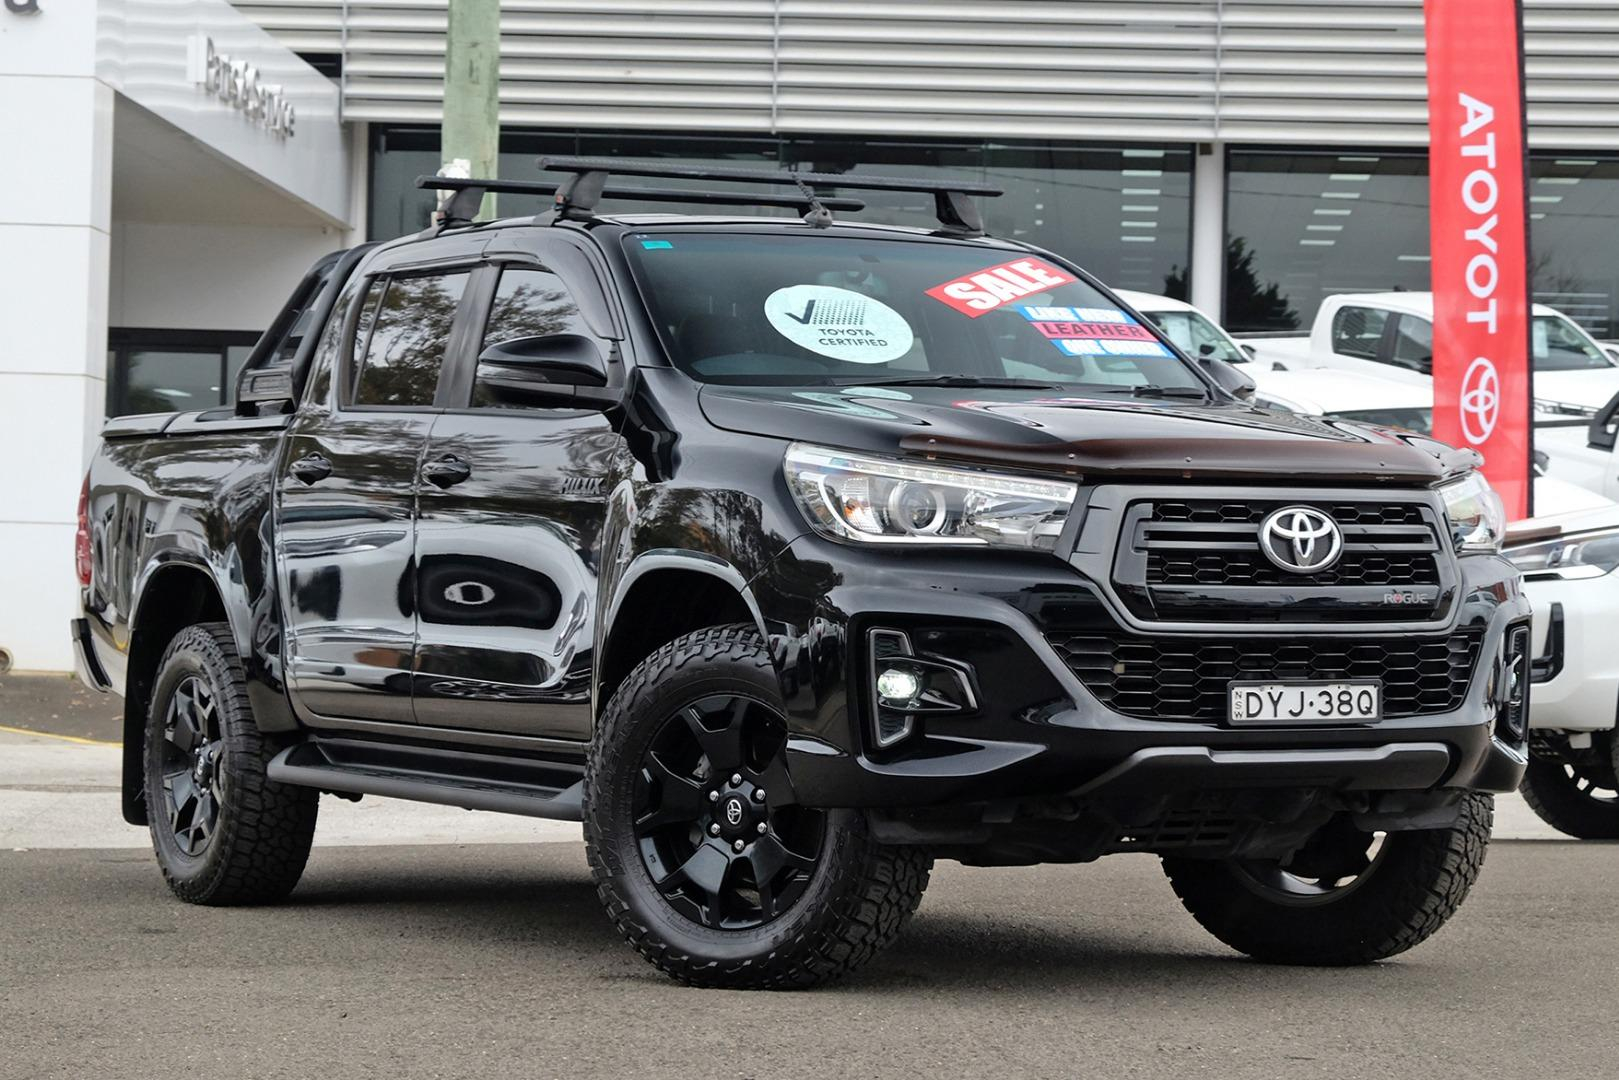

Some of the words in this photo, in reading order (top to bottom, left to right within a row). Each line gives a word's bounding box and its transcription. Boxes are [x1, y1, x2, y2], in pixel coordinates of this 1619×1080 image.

[943, 260, 1067, 310] SALE
[818, 328, 875, 336] TOYOTA
[1041, 323, 1145, 337] LEATHER
[818, 338, 888, 347] CERTIFIED
[1383, 593, 1429, 604] ROGUE
